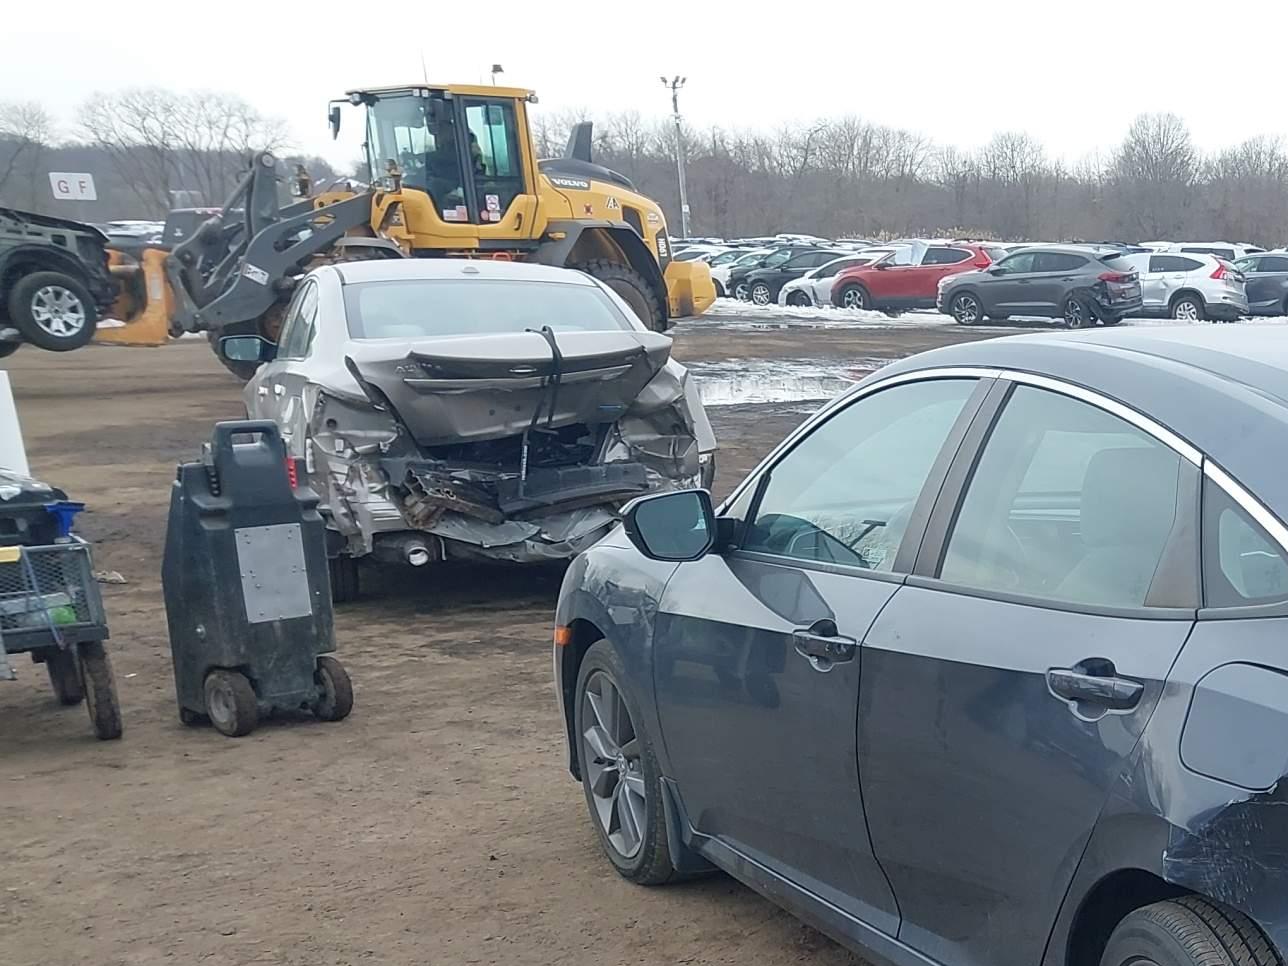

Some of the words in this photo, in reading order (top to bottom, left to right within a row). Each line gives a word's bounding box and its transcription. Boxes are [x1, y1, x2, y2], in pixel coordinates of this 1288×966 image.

[57, 180, 70, 194] G
[79, 180, 87, 194] F
[550, 178, 589, 188] VOLVO
